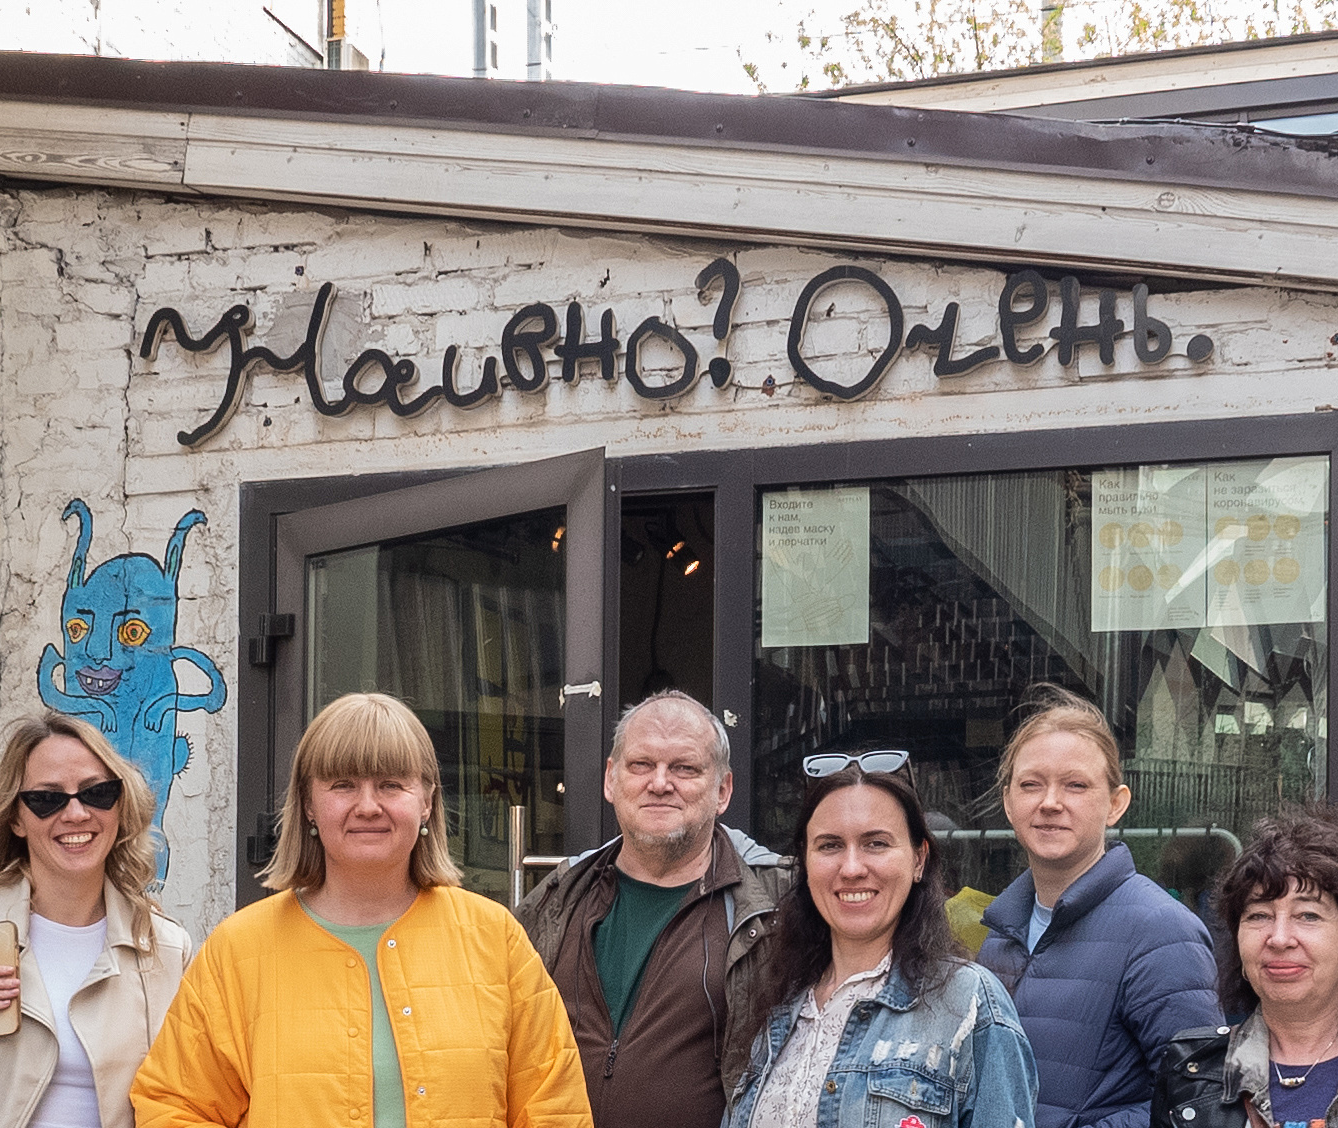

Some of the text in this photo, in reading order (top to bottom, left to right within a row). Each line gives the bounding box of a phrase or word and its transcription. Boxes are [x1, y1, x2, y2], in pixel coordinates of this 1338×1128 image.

[786, 264, 1216, 403] Очень.
[1213, 471, 1236, 482] Как
[1098, 479, 1121, 489] Как
[1098, 491, 1159, 503] правильно
[769, 499, 814, 510] Входите
[1098, 506, 1128, 515] мыть
[769, 513, 801, 523] к нам,
[768, 524, 835, 535] надев маску
[768, 537, 827, 548] и перчатки
